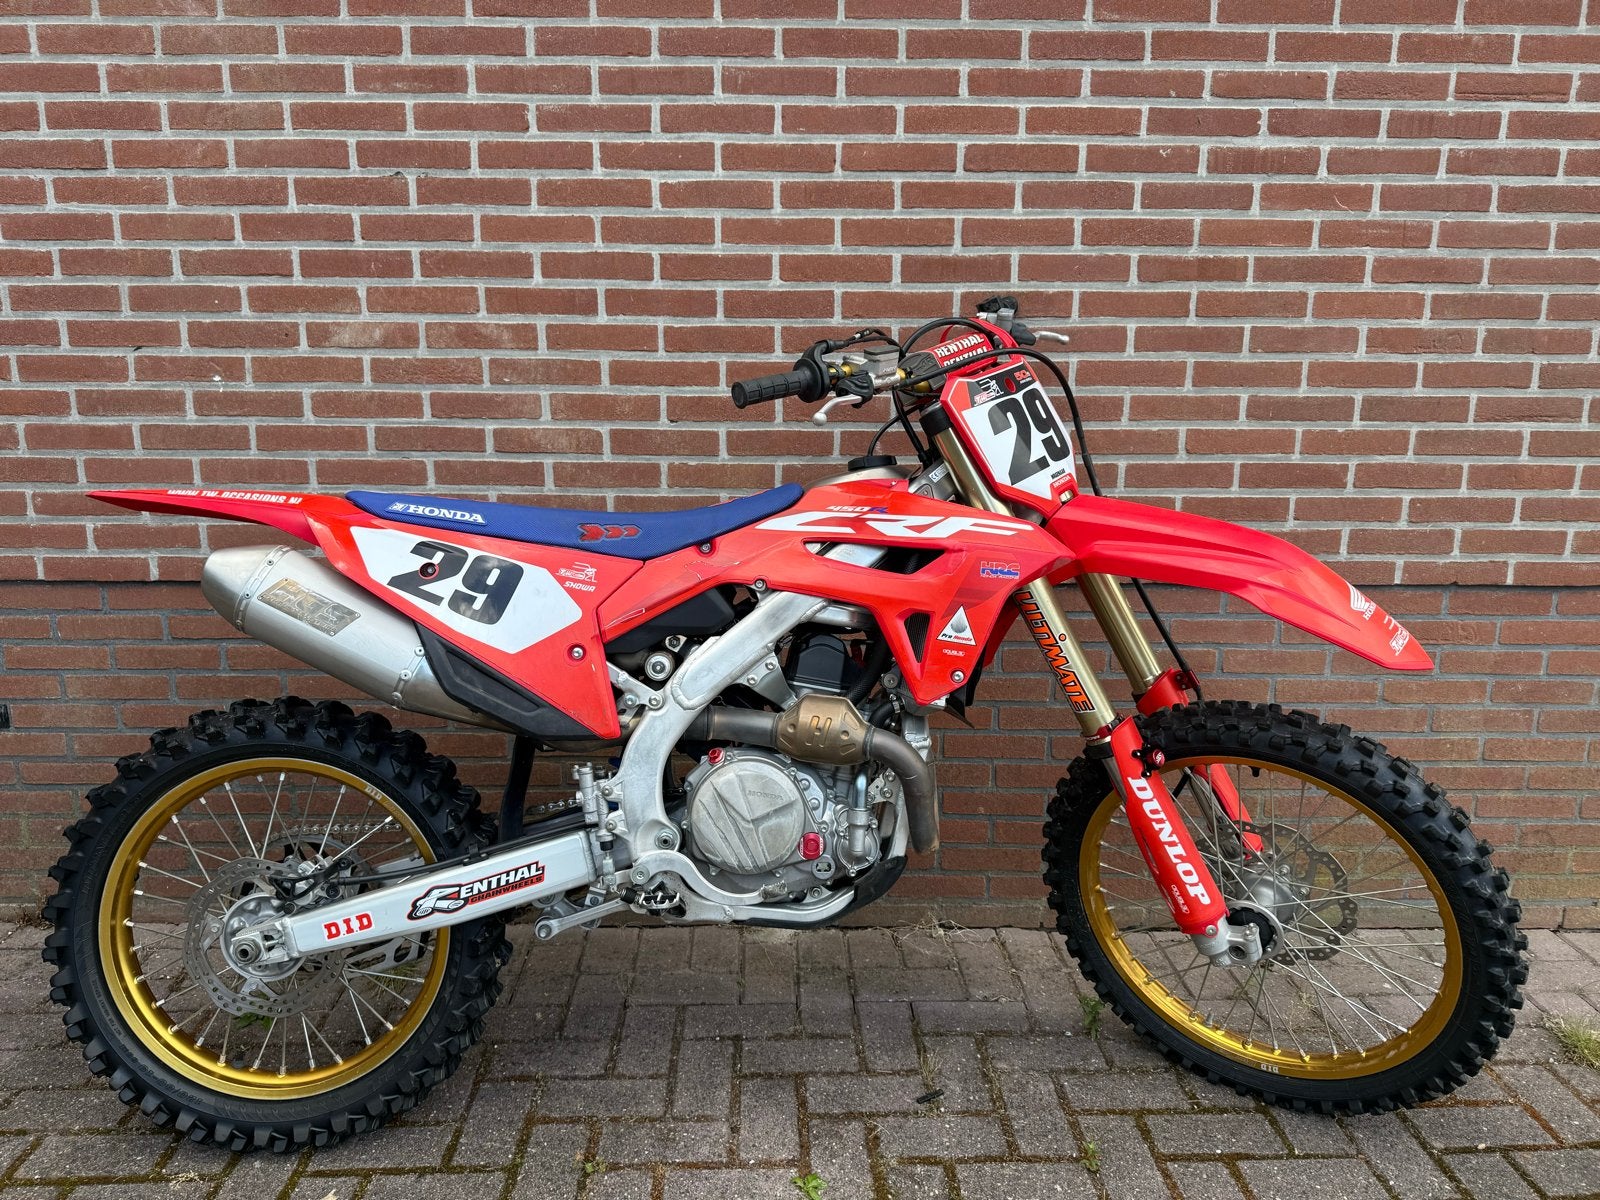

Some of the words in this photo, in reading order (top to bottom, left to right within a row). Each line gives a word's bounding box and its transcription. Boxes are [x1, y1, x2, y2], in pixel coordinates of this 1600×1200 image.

[934, 334, 985, 358] RENTHAL
[988, 388, 1070, 486] 29
[407, 503, 486, 524] HONDA
[825, 505, 888, 514] 450R
[754, 511, 1034, 538] CRF
[980, 561, 1020, 577] HRC
[387, 541, 525, 625] 29
[563, 580, 596, 592] SHOWA
[1014, 590, 1096, 712] ULTIMATE
[1127, 776, 1212, 906] DUNLOP
[407, 863, 544, 918] RENTHAL
[470, 876, 543, 904] CHAINWHEELS
[323, 913, 373, 940] D.I.D
